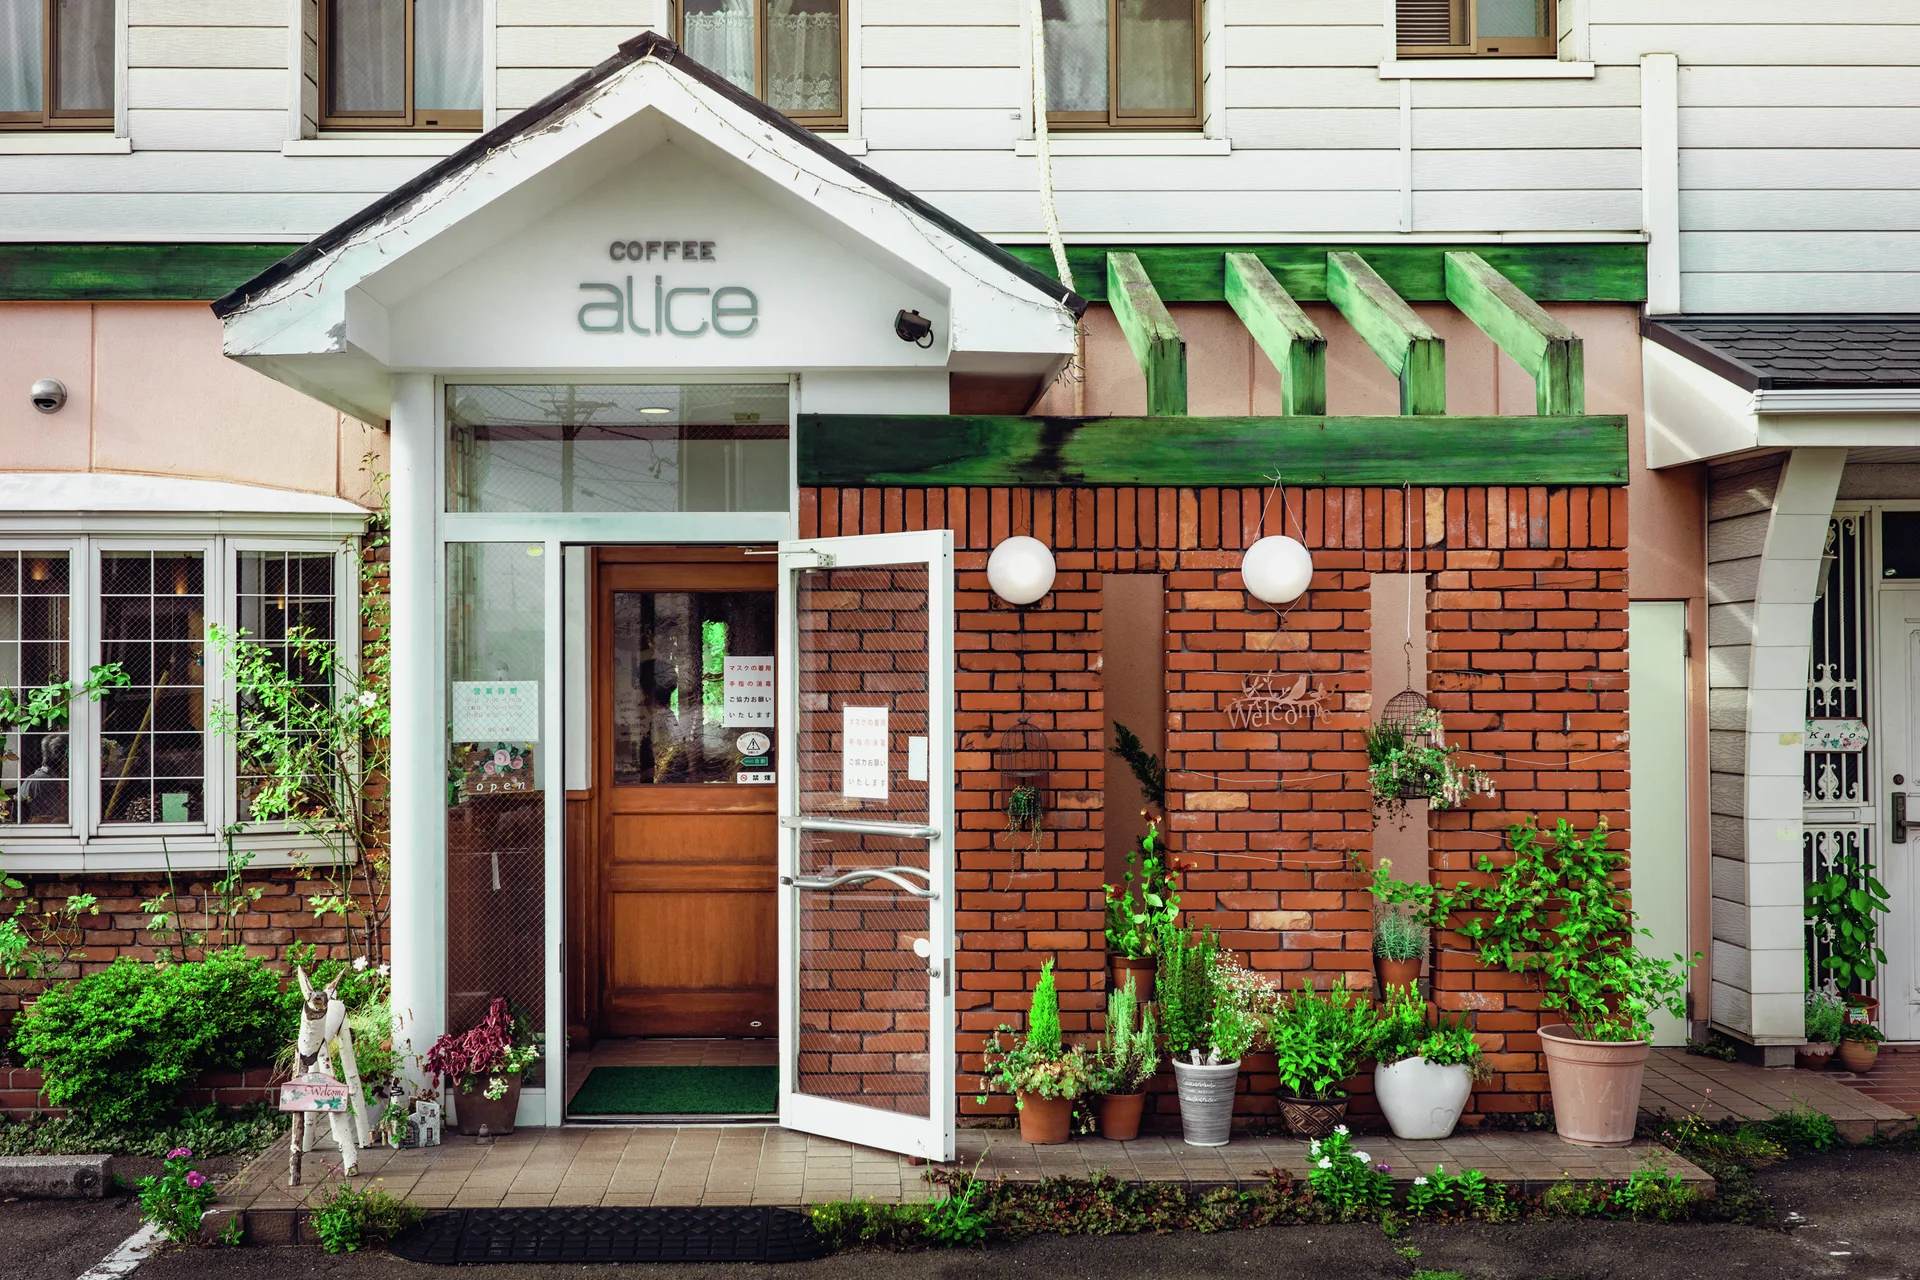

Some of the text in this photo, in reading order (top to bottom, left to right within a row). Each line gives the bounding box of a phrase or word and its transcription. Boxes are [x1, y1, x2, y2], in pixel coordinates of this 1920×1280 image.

[609, 240, 716, 262] COFFEE
[577, 275, 758, 338] alice
[1227, 699, 1333, 729] Welcome
[849, 718, 886, 727] マスクの着用
[1809, 731, 1856, 739] Kato
[849, 758, 886, 767] ご協力お願い
[476, 781, 526, 793] open
[849, 778, 886, 787] いたします
[304, 1083, 345, 1097] Welcome
